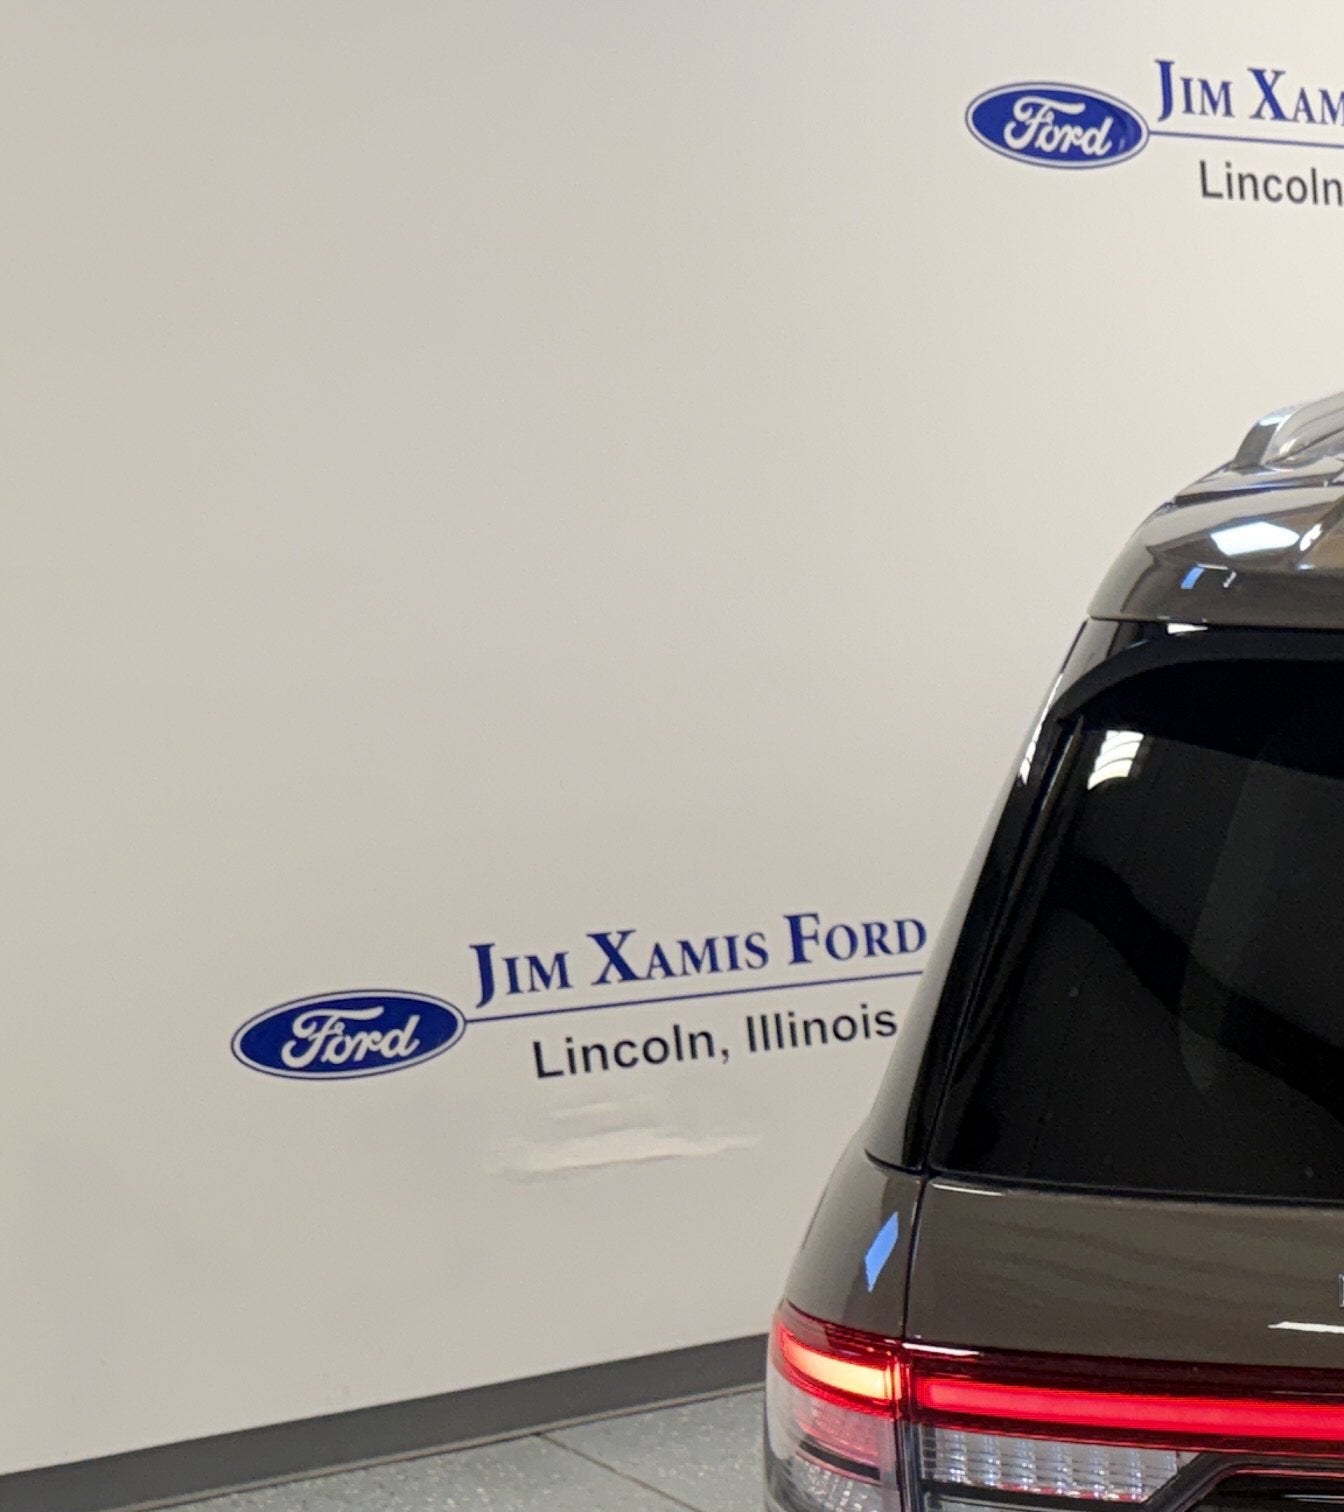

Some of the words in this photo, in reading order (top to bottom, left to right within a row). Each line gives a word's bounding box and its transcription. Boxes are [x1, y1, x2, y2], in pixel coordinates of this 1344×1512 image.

[1154, 59, 1236, 122] JIM
[1003, 96, 1114, 157] Ford
[469, 942, 570, 1009] JIM
[586, 929, 769, 986] XAMIS
[783, 912, 927, 964] FORD
[281, 1005, 420, 1069] Ford
[533, 1024, 730, 1079] Lincoln,
[745, 1003, 898, 1054] Illinois
